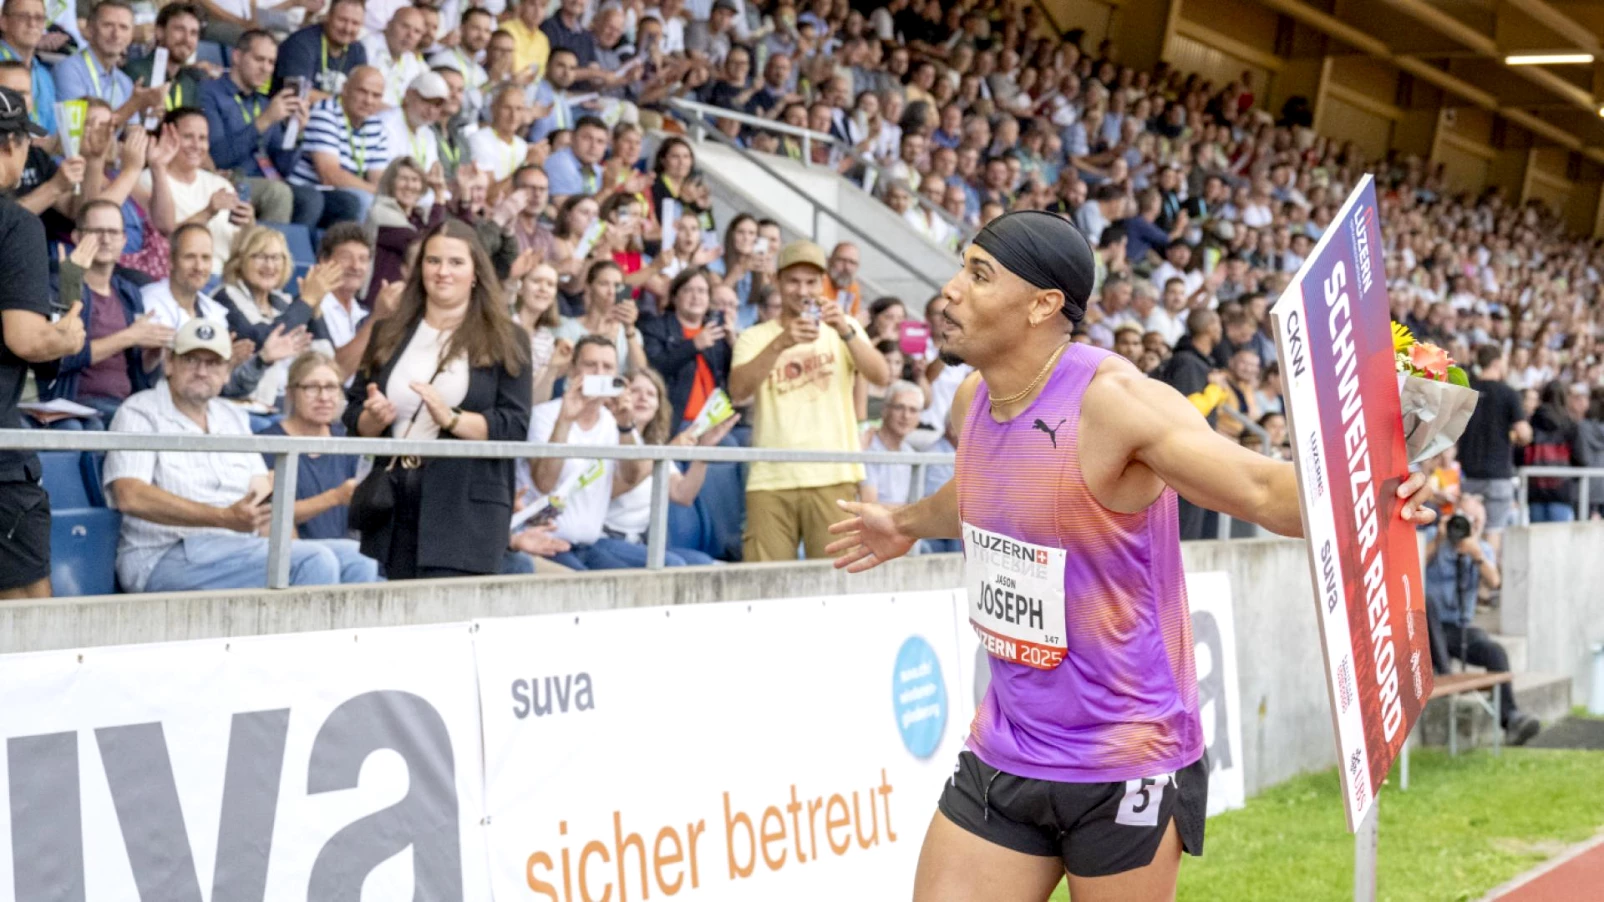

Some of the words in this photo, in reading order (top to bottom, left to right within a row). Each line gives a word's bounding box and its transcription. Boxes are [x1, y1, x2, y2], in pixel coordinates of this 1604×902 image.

[1353, 204, 1374, 294] LUZERN
[1323, 260, 1379, 562] SCHWEIZER
[1364, 550, 1402, 743] REKORD
[971, 530, 1035, 562] LUZERN
[995, 574, 1017, 590] JASON
[1320, 539, 1338, 615] suva
[976, 581, 1044, 630] JOSEPH
[1020, 644, 1063, 667] 2025
[1044, 634, 1060, 645] 147
[511, 671, 595, 719] suva
[1132, 778, 1156, 813] 5
[526, 810, 706, 902] sicher
[723, 767, 898, 881] betreut
